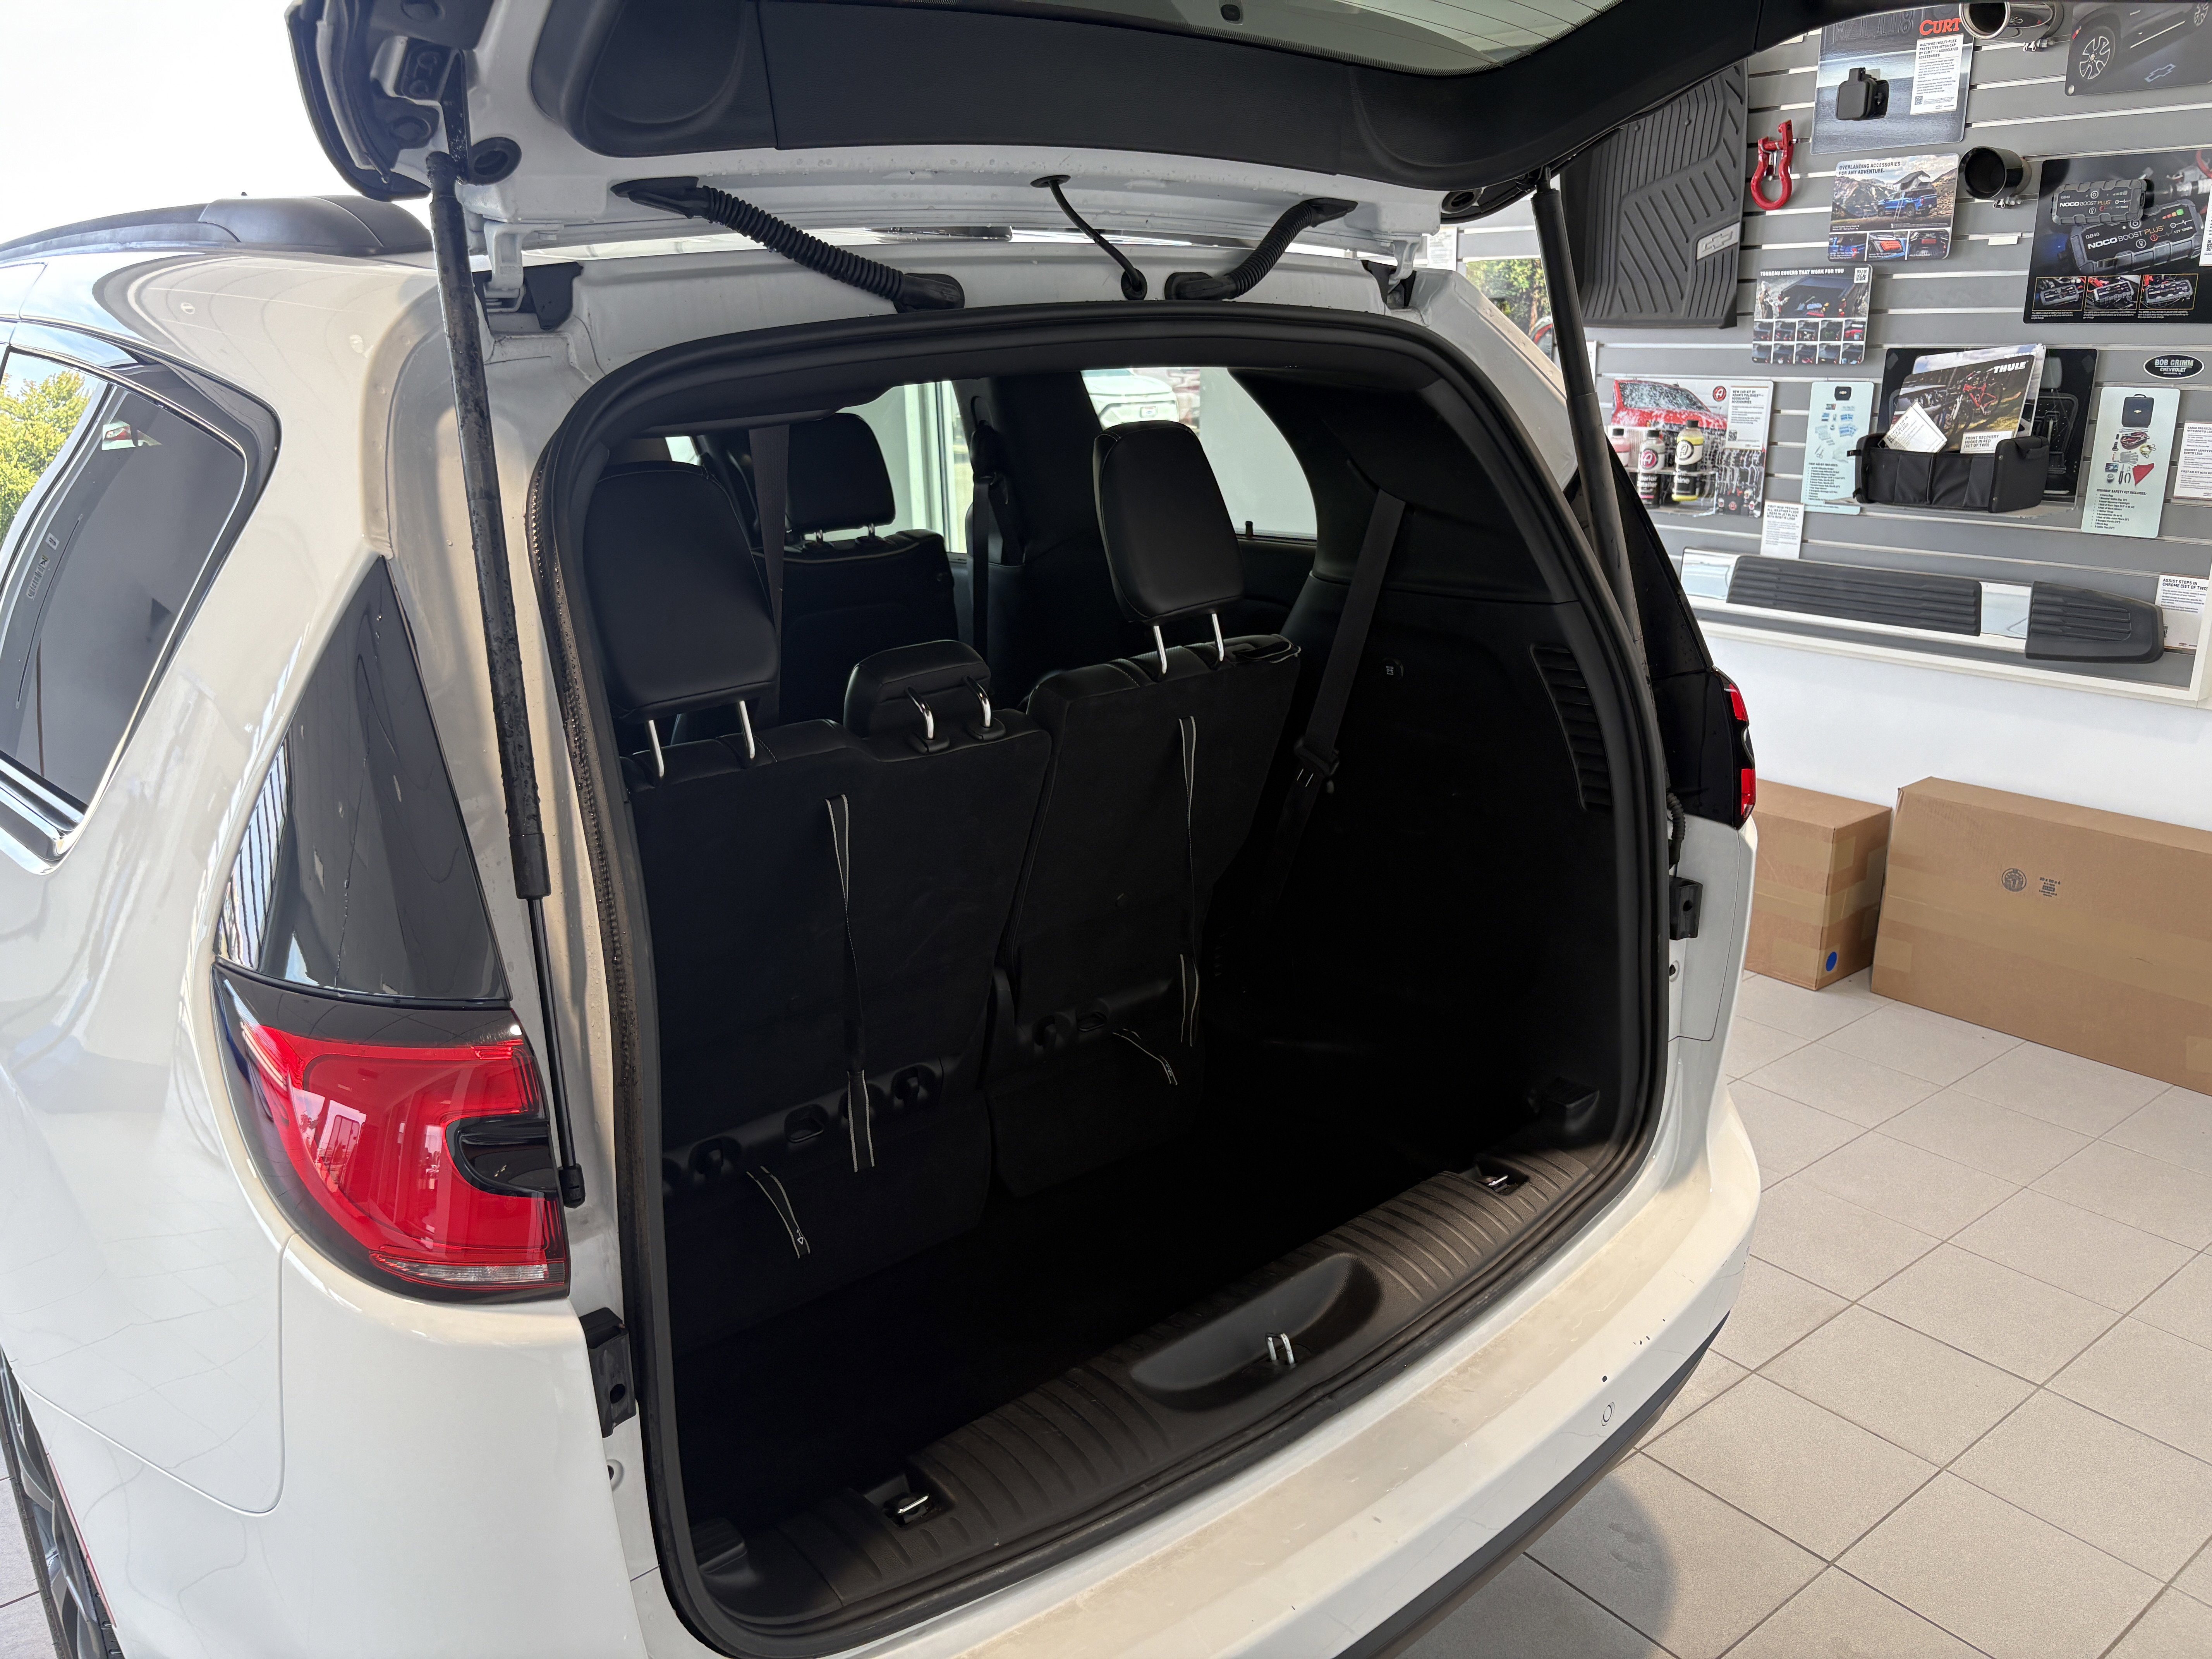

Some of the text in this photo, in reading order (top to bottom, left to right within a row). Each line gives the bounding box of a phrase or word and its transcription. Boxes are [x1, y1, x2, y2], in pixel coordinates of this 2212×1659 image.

[1920, 18, 1961, 36] CURT
[2087, 225, 2163, 249] NOCO BOOST PLUS
[1994, 361, 2026, 374] THULE
